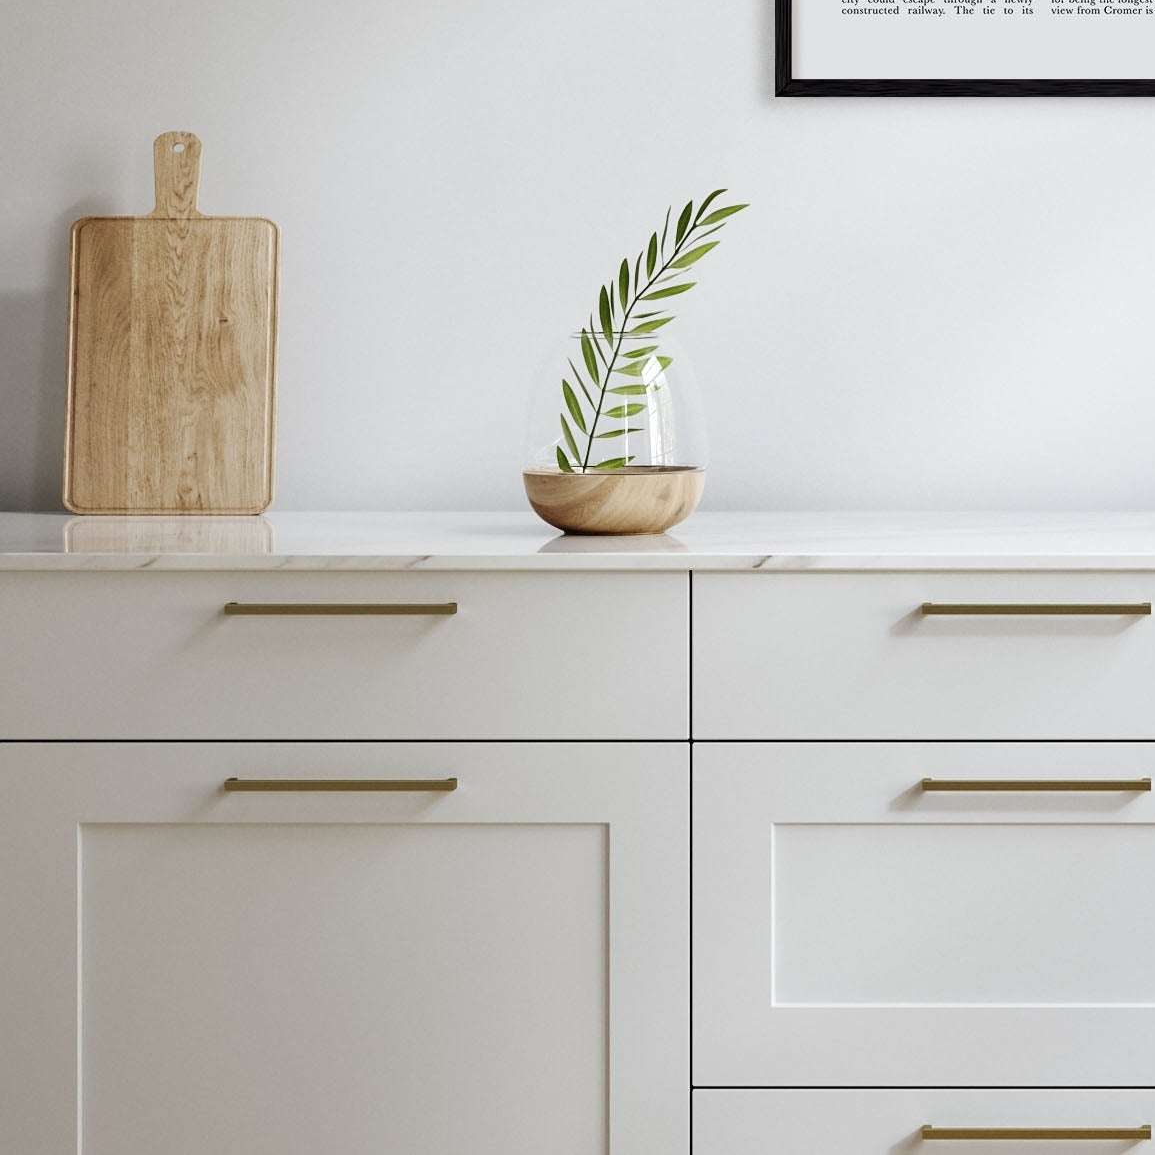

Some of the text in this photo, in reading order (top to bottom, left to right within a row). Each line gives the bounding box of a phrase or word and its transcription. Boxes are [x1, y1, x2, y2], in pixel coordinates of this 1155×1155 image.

[841, 6, 900, 14] constructed
[907, 6, 946, 17] railway.
[955, 6, 975, 14] The
[982, 6, 996, 14] tie
[1022, 6, 1034, 14] its
[1050, 6, 1074, 14] view
[1077, 6, 1101, 14] from
[1103, 6, 1143, 14] Cromer
[1145, 6, 1154, 14] is
